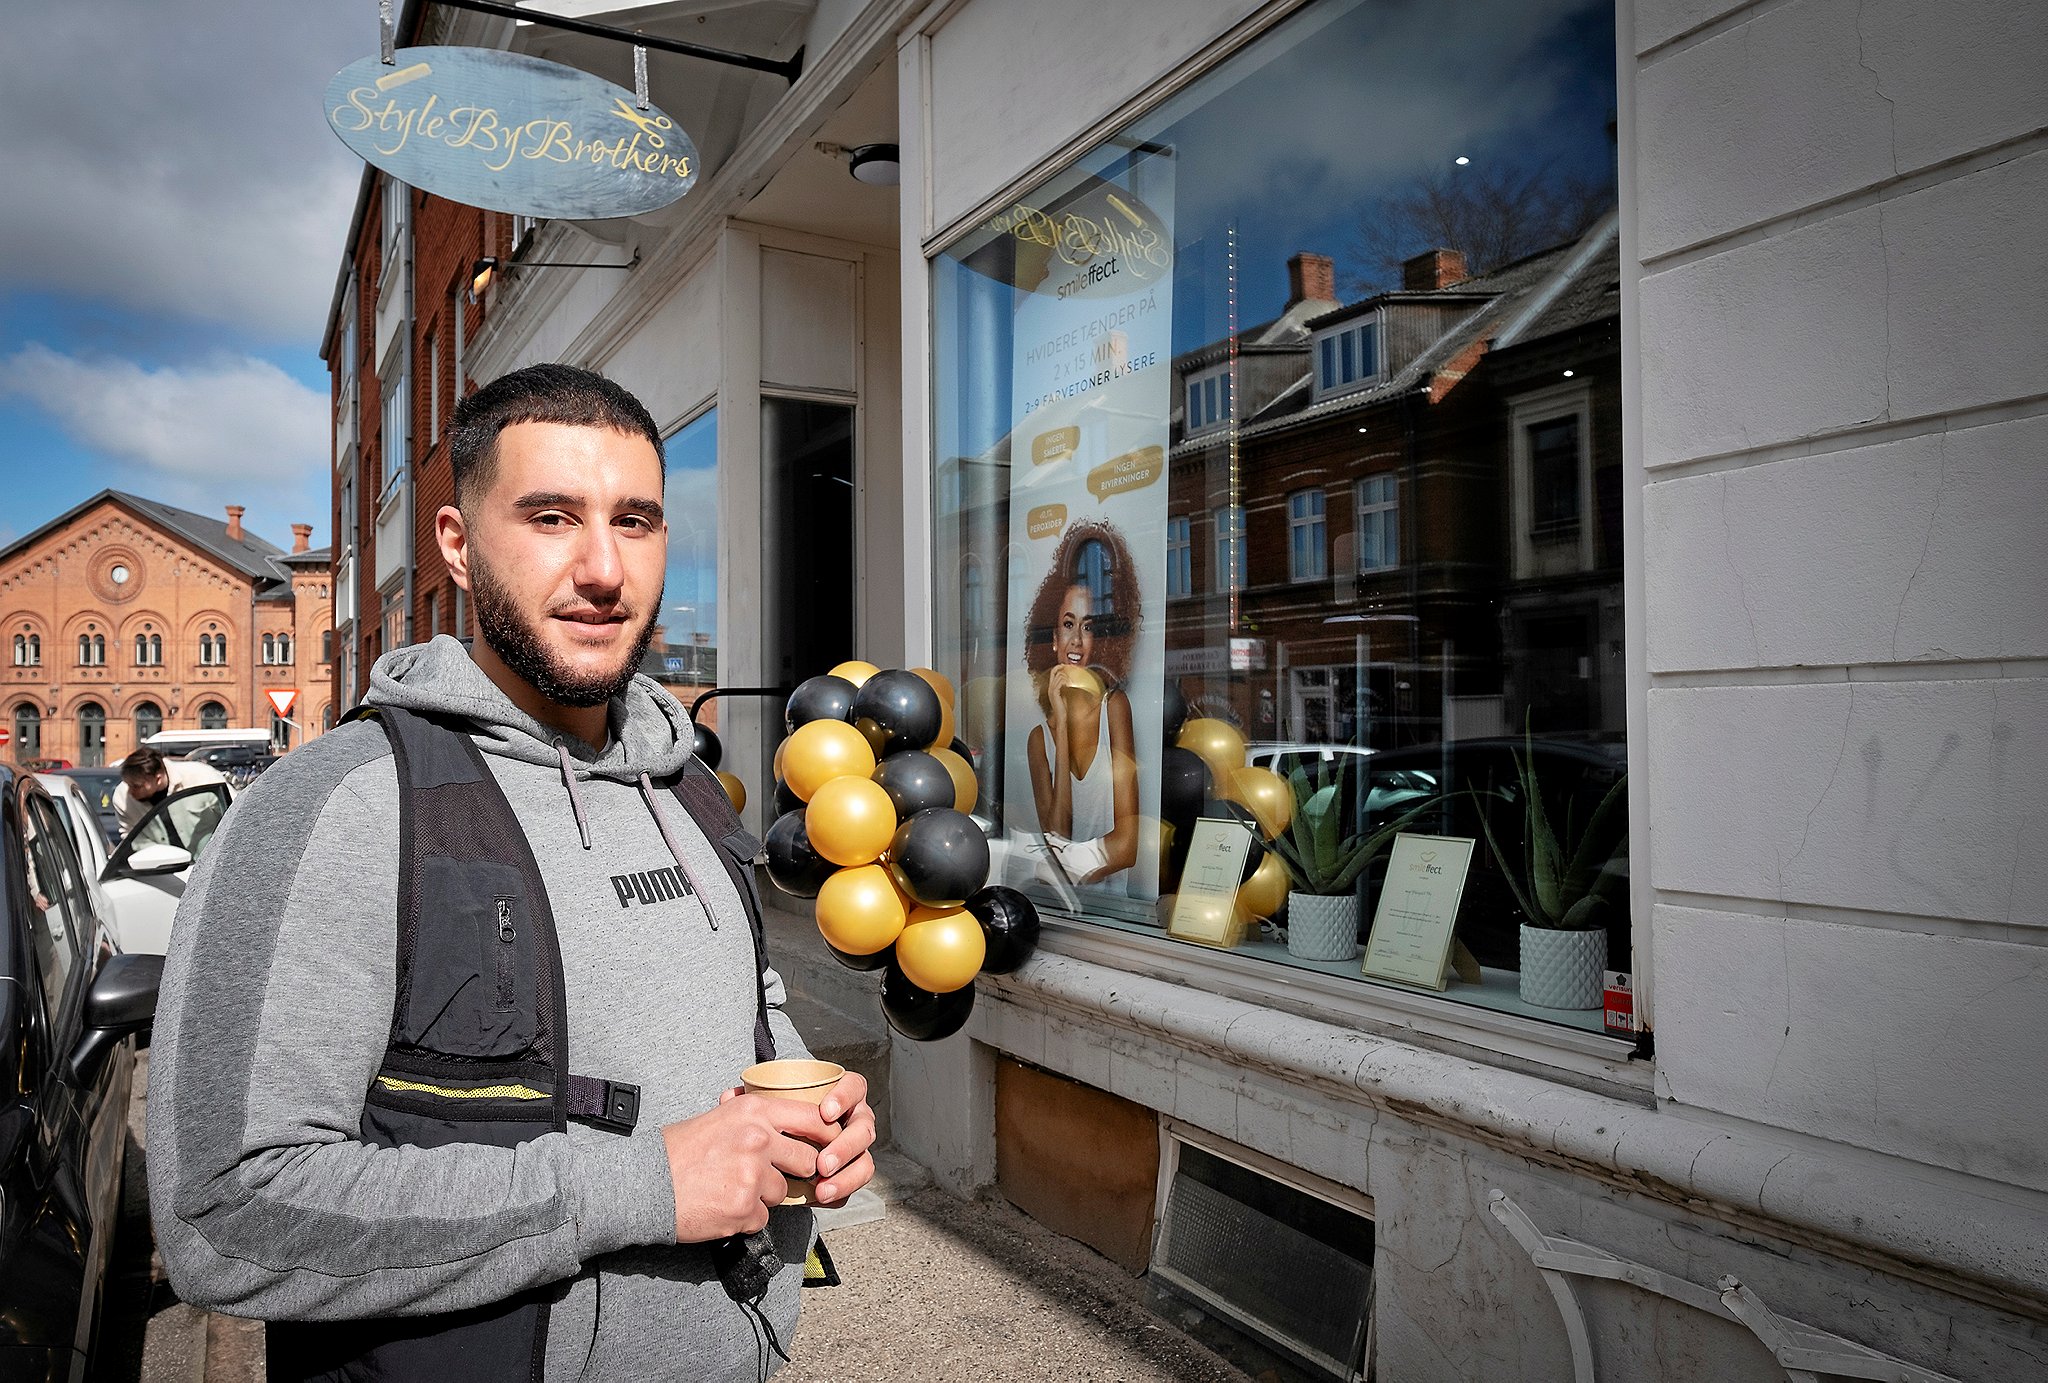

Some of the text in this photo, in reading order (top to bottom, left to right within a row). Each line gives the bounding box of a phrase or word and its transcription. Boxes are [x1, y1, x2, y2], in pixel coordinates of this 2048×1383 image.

[1026, 288, 1158, 366] HVIDERE TÆNDER PÅ
[1025, 351, 1156, 414] 2-9 FARVETONER LYSERE
[1053, 364, 1061, 381] 2
[1074, 355, 1086, 373] 15
[1113, 460, 1136, 474] INGEN
